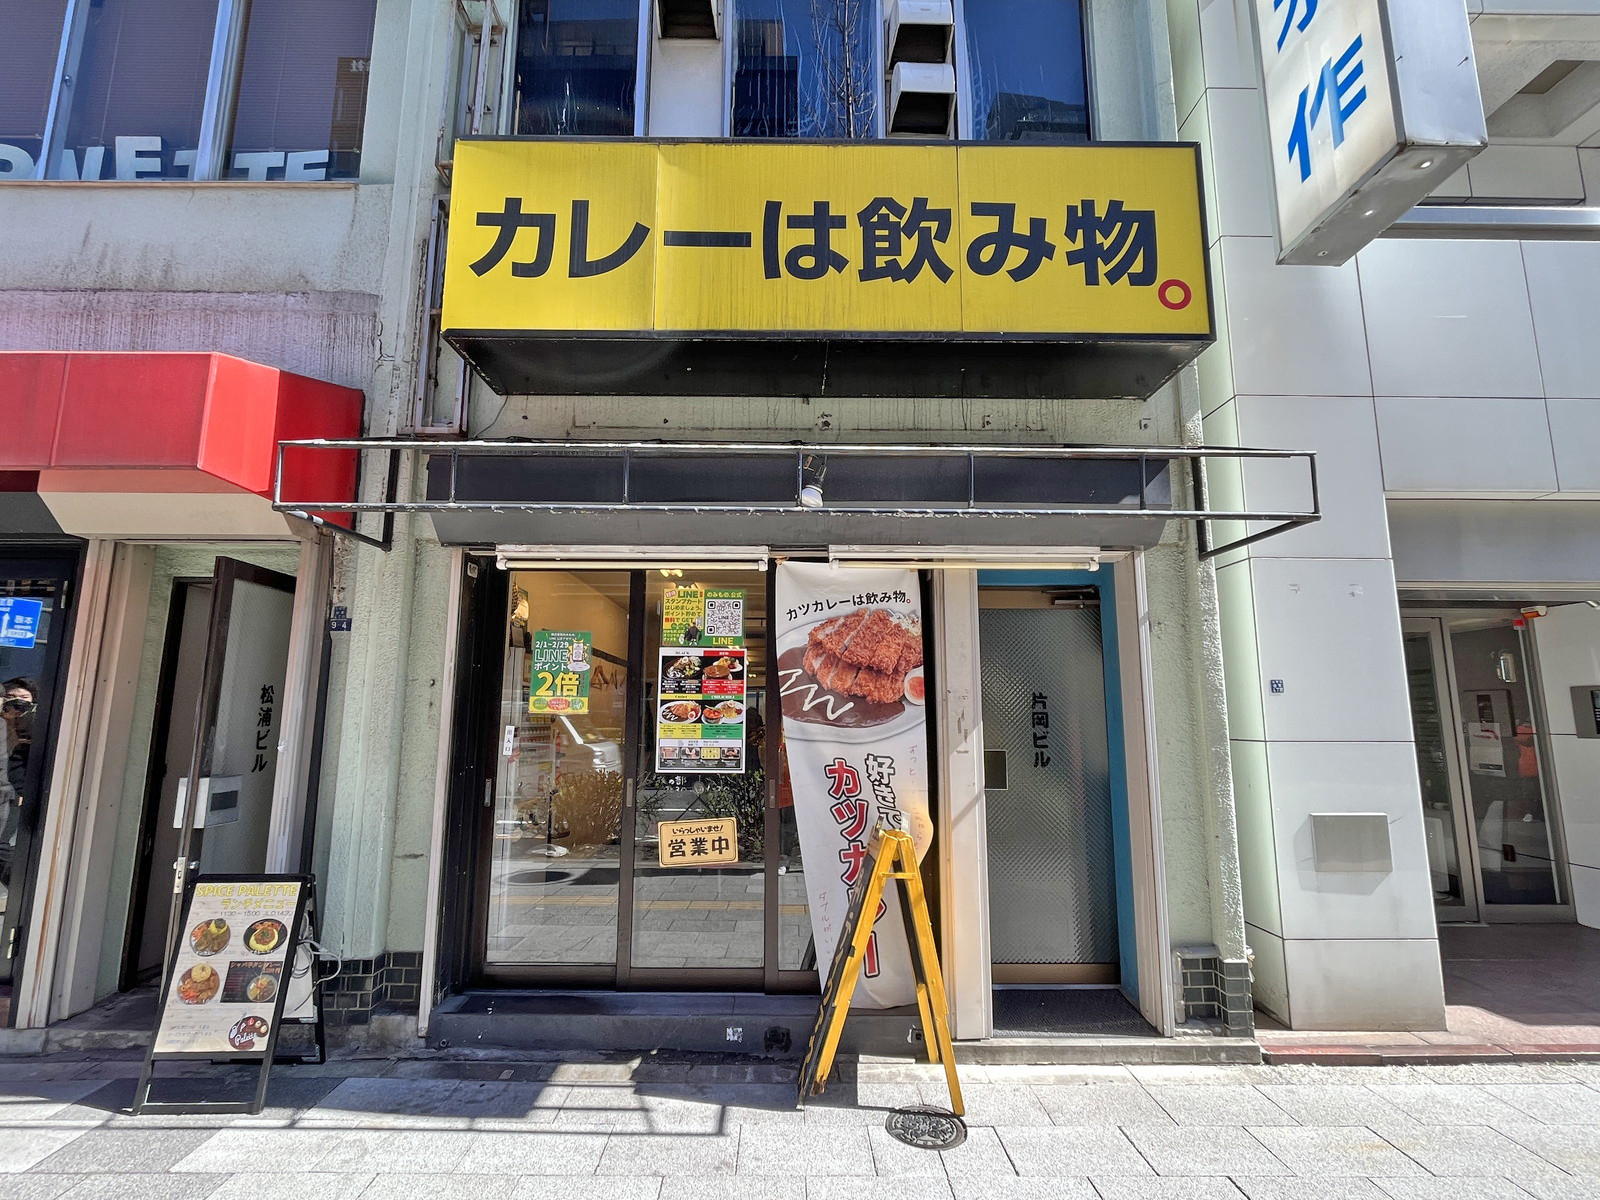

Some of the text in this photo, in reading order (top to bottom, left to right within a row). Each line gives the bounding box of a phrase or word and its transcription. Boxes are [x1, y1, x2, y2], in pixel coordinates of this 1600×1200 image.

[1273, 0, 1367, 183] 作
[468, 195, 1193, 311] カレーは飲み物。
[677, 590, 699, 598] LINE
[786, 590, 912, 621] カツカレーは飲み物。
[712, 637, 734, 645] LINE
[534, 649, 569, 662] LINE
[534, 662, 567, 671] ポイント
[535, 671, 579, 697] 2倍
[251, 684, 274, 773] 松浦ビル
[1031, 691, 1051, 769] 片岡ビル
[667, 836, 730, 858] 営業中
[825, 758, 887, 979] カツカー
[196, 884, 298, 897] SPICE PALETTE
[221, 898, 297, 910] ランチメニュー
